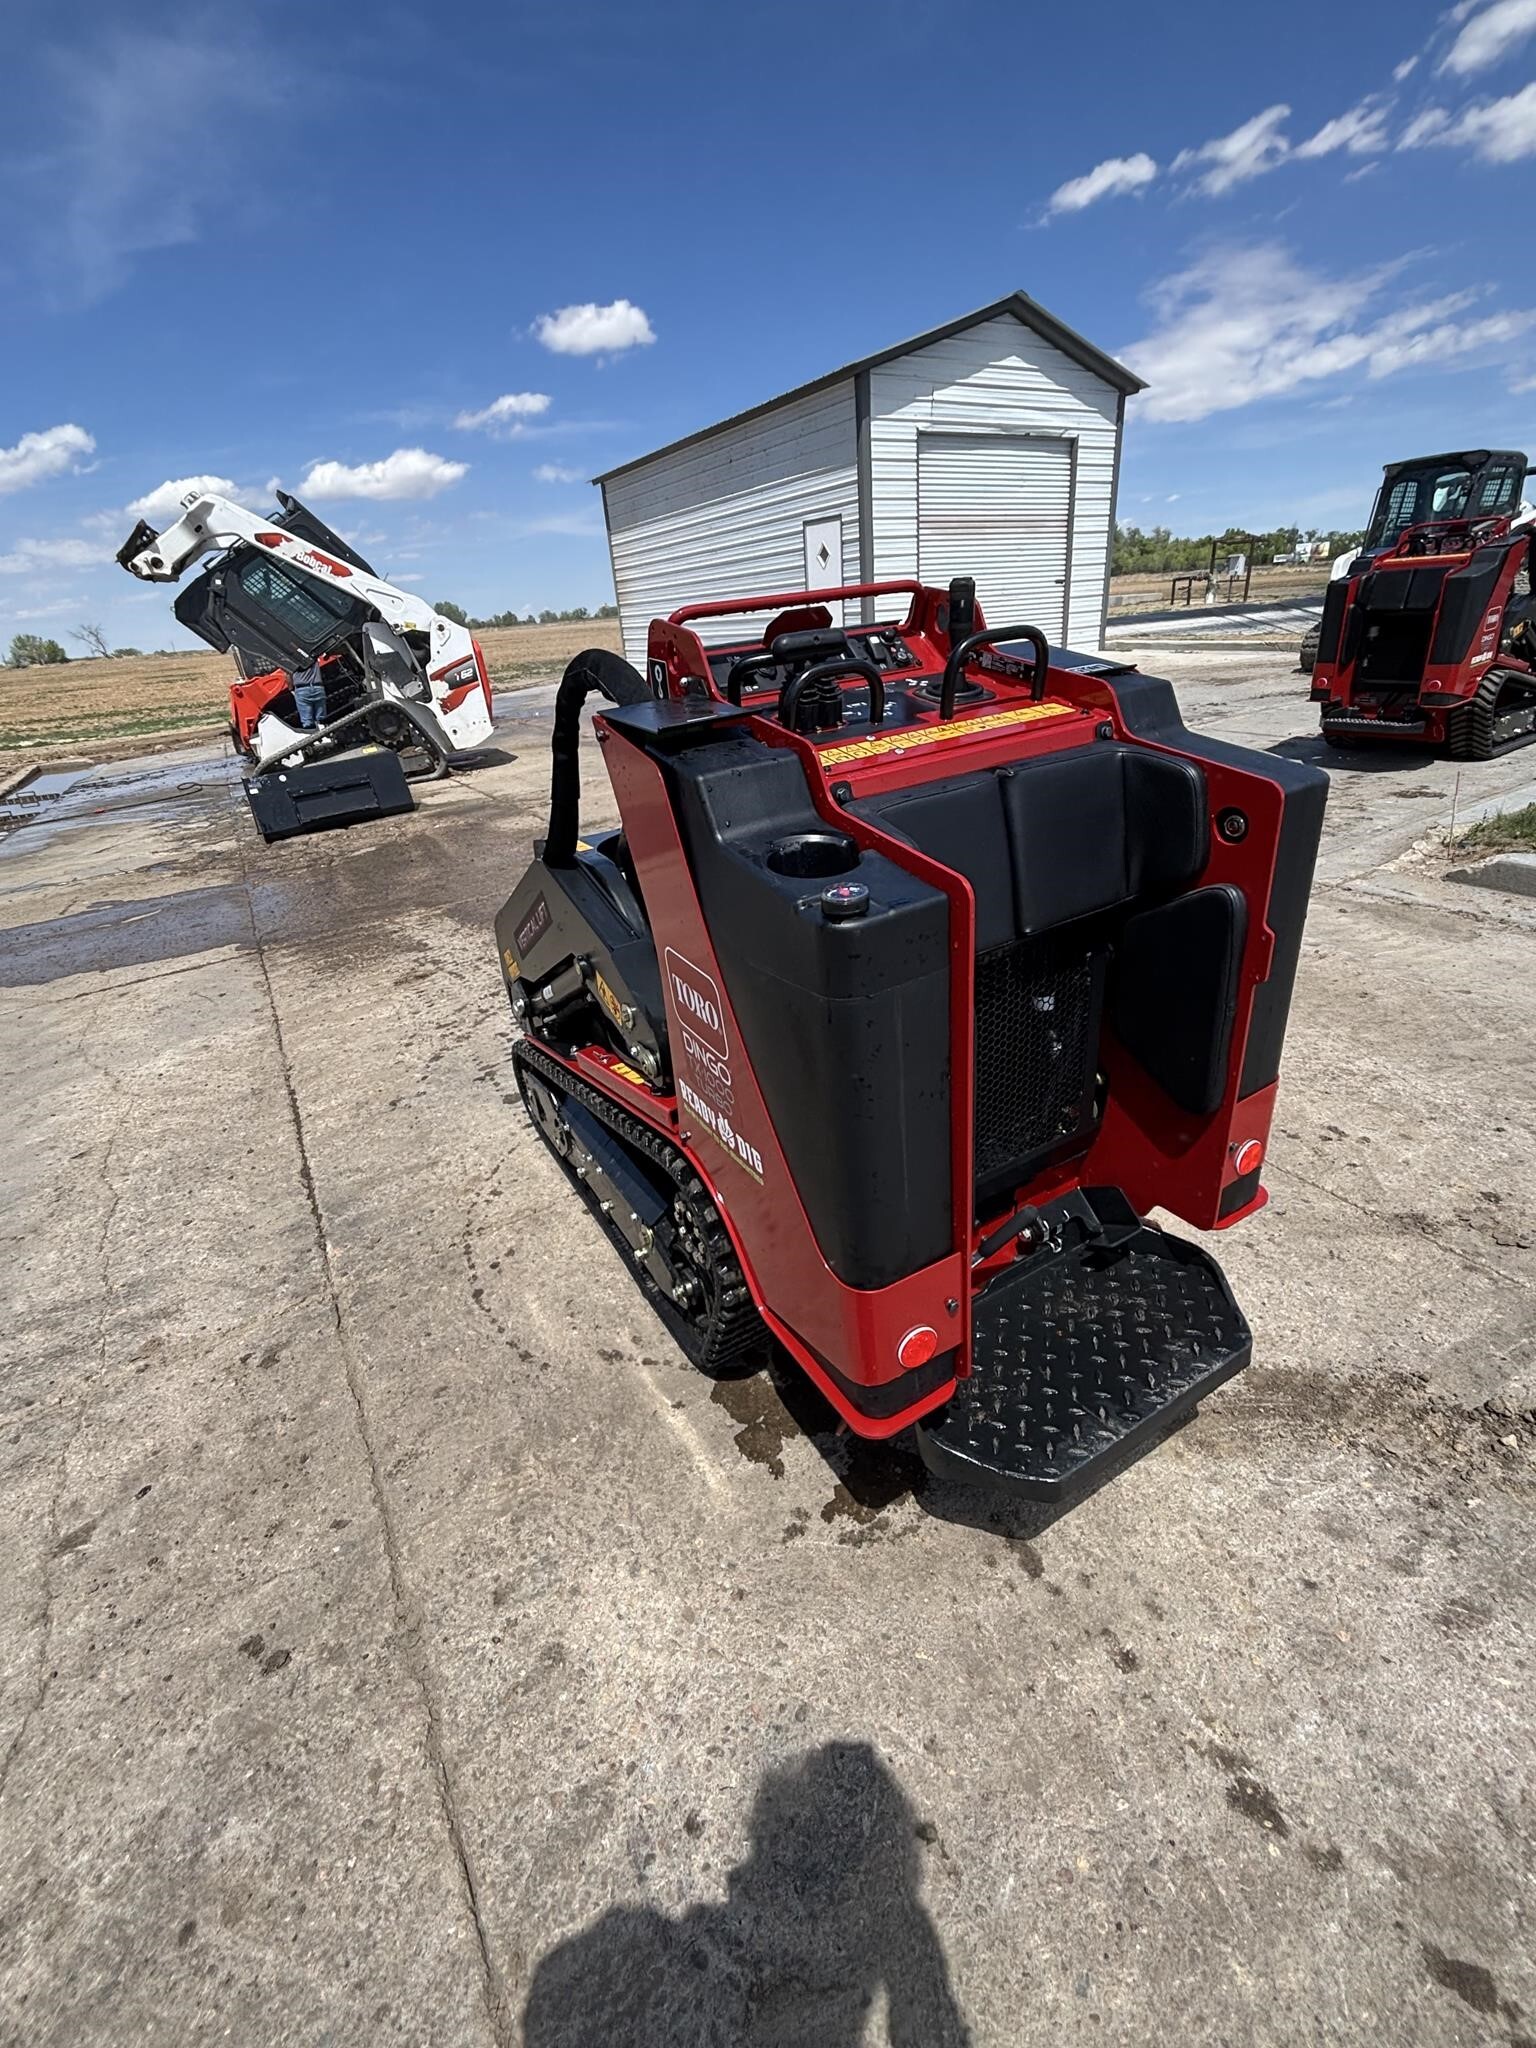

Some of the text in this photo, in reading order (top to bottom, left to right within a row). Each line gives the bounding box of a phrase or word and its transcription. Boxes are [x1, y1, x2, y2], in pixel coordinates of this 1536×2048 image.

[296, 550, 332, 574] Bobcat
[672, 973, 719, 1030] TORO
[682, 1031, 731, 1086] DINGO
[678, 1078, 716, 1130] READY
[735, 1133, 764, 1174] DIG
